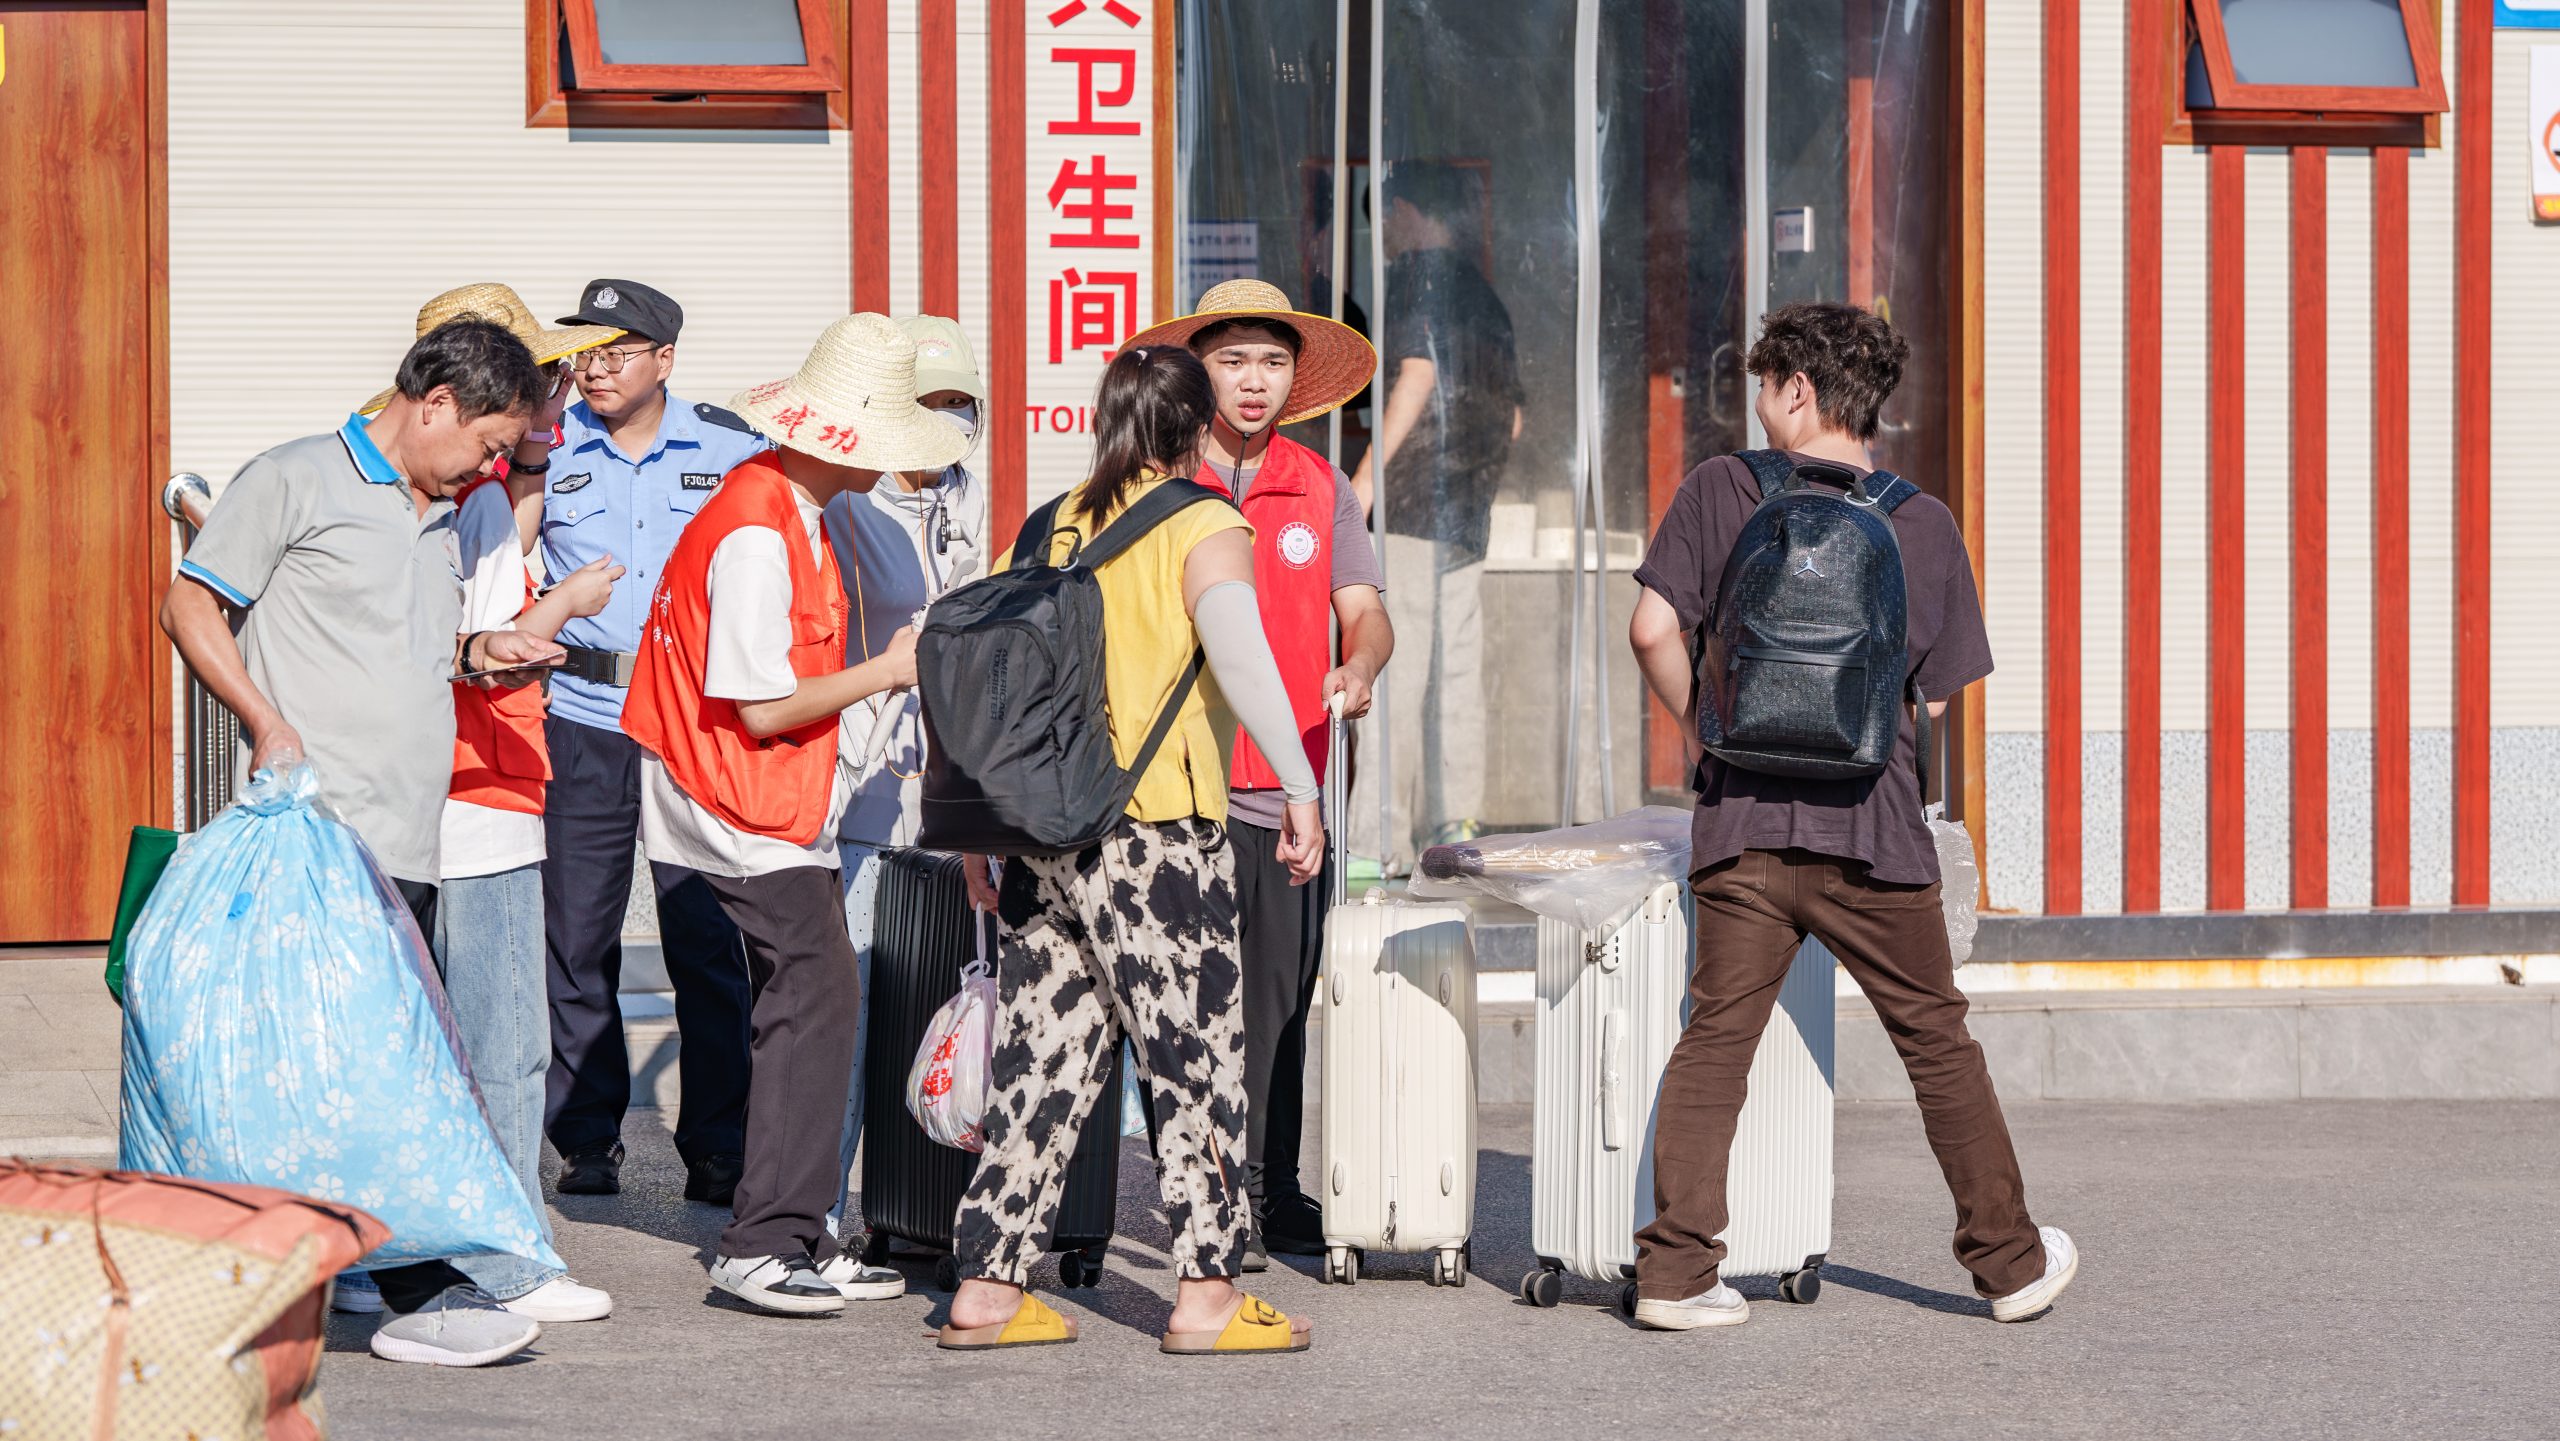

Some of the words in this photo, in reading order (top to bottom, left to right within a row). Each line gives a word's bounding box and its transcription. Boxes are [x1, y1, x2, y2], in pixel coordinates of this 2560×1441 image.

[771, 404, 859, 454] 成功
[683, 475, 719, 487] FJ0145
[990, 647, 1003, 721] TOURISTER
[998, 647, 1008, 721] AMERICAN
